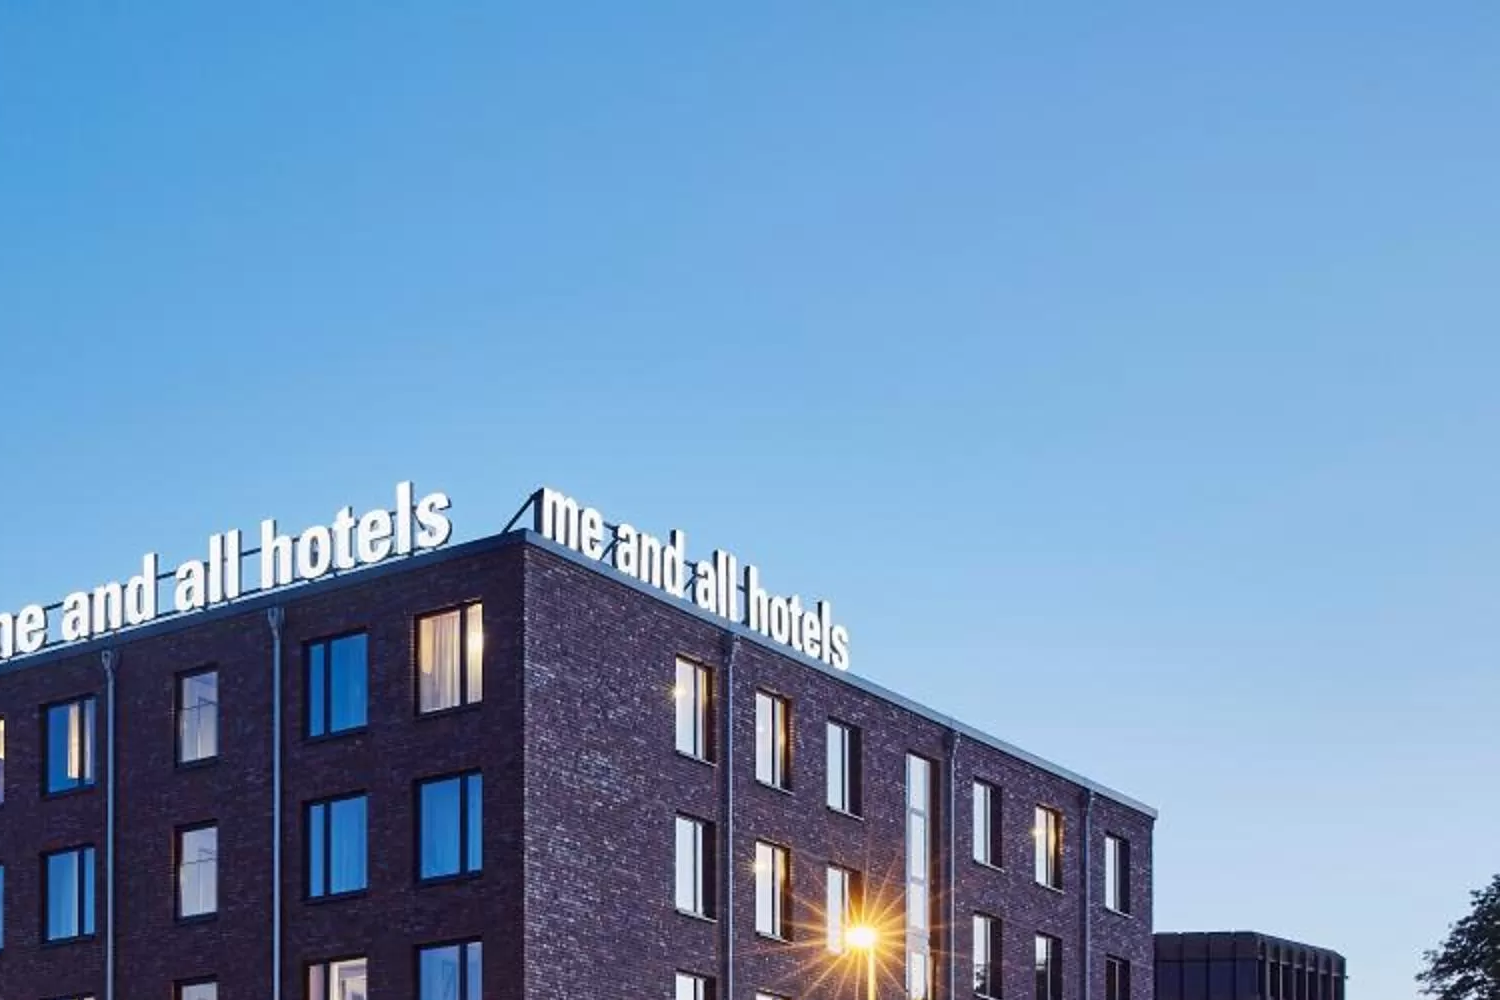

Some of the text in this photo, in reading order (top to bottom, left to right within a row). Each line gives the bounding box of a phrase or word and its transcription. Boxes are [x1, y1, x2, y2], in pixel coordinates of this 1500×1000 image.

[60, 552, 158, 641] and
[174, 528, 242, 609] all
[261, 479, 451, 590] hotels
[539, 487, 851, 671] me and all hotels
